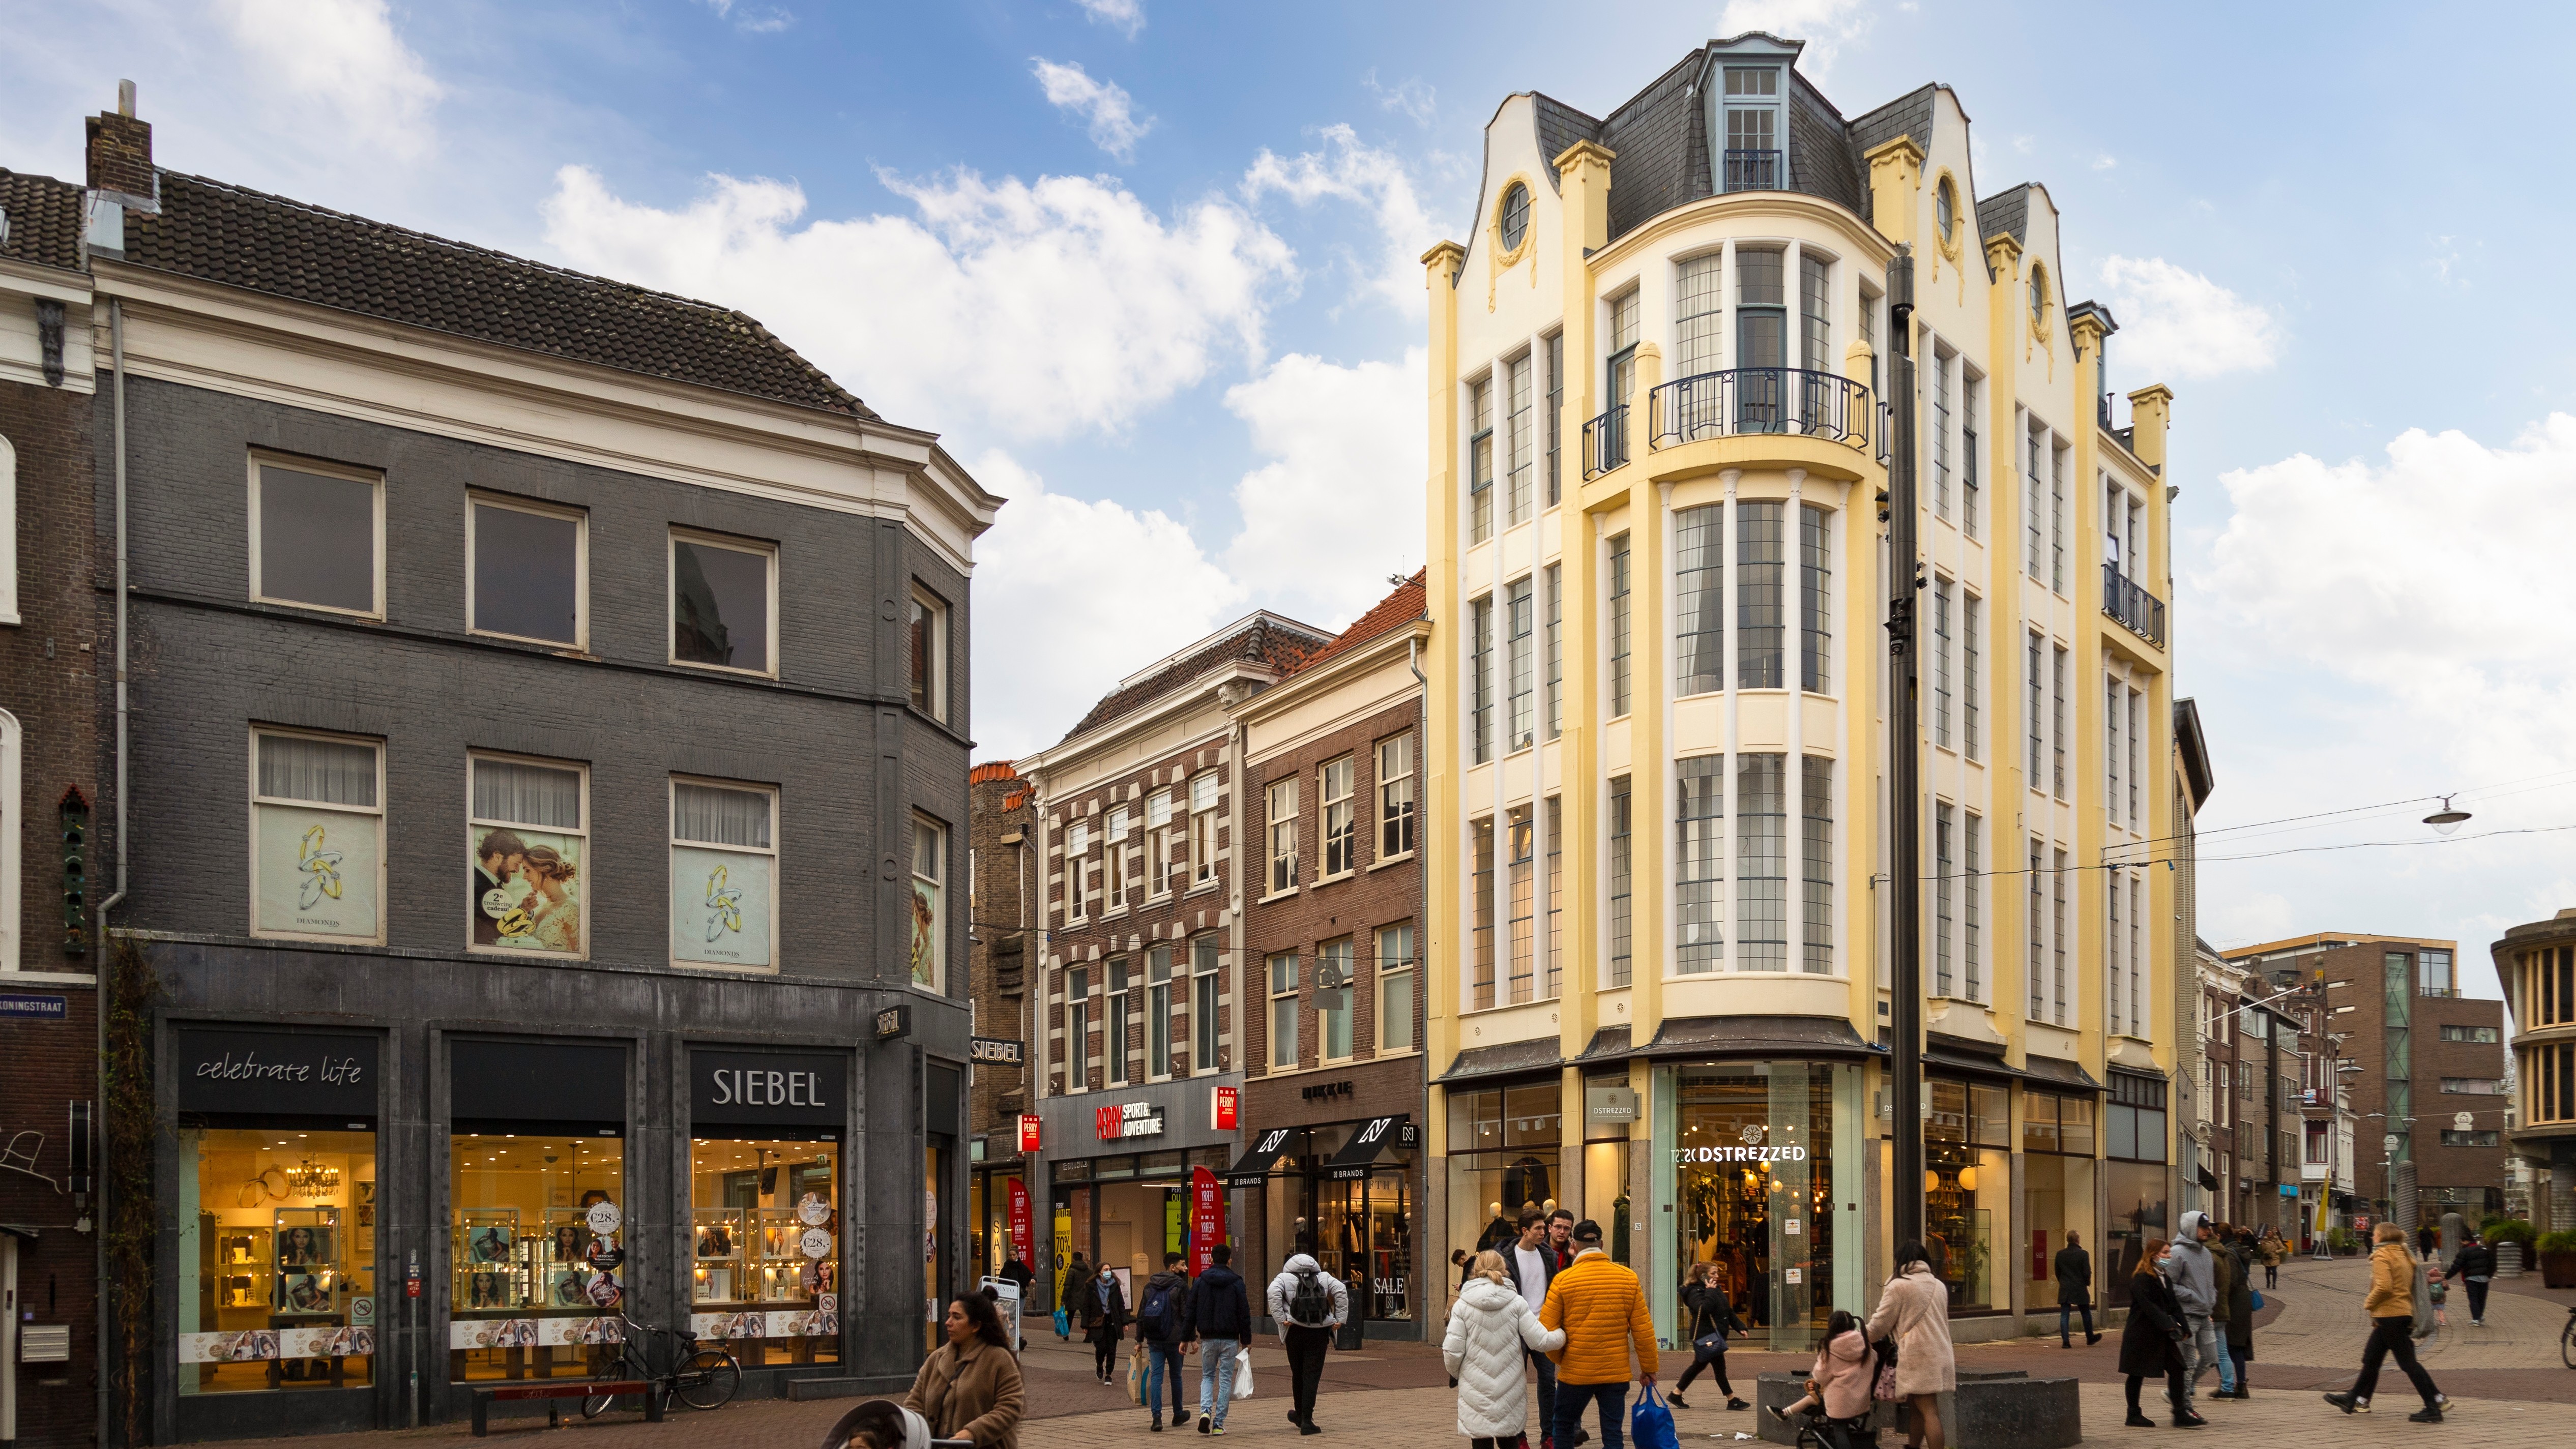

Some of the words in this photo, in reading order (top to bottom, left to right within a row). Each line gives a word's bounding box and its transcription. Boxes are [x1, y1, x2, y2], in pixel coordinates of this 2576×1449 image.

[493, 893, 504, 902] 2e
[297, 918, 340, 926] DIAMONDS
[970, 1040, 1022, 1063] SIEBEL
[196, 1051, 310, 1081] celebrate
[321, 1056, 362, 1085] life
[713, 1070, 826, 1107] SIEBEL
[1219, 1096, 1235, 1108] PERRY
[1123, 1102, 1151, 1119] SPORT&
[1024, 1123, 1037, 1133] PERRY
[1096, 1105, 1123, 1140] PERRY
[1123, 1118, 1163, 1137] ADVENTURE
[1402, 1127, 1414, 1141] N
[1699, 1146, 1805, 1162] DSTREZZED
[590, 1213, 620, 1225] €28,-
[1056, 1208, 1071, 1218] OUTLET
[803, 1237, 830, 1249] €28,-
[1056, 1235, 1071, 1253] 70%
[1374, 1278, 1404, 1294] SALE
